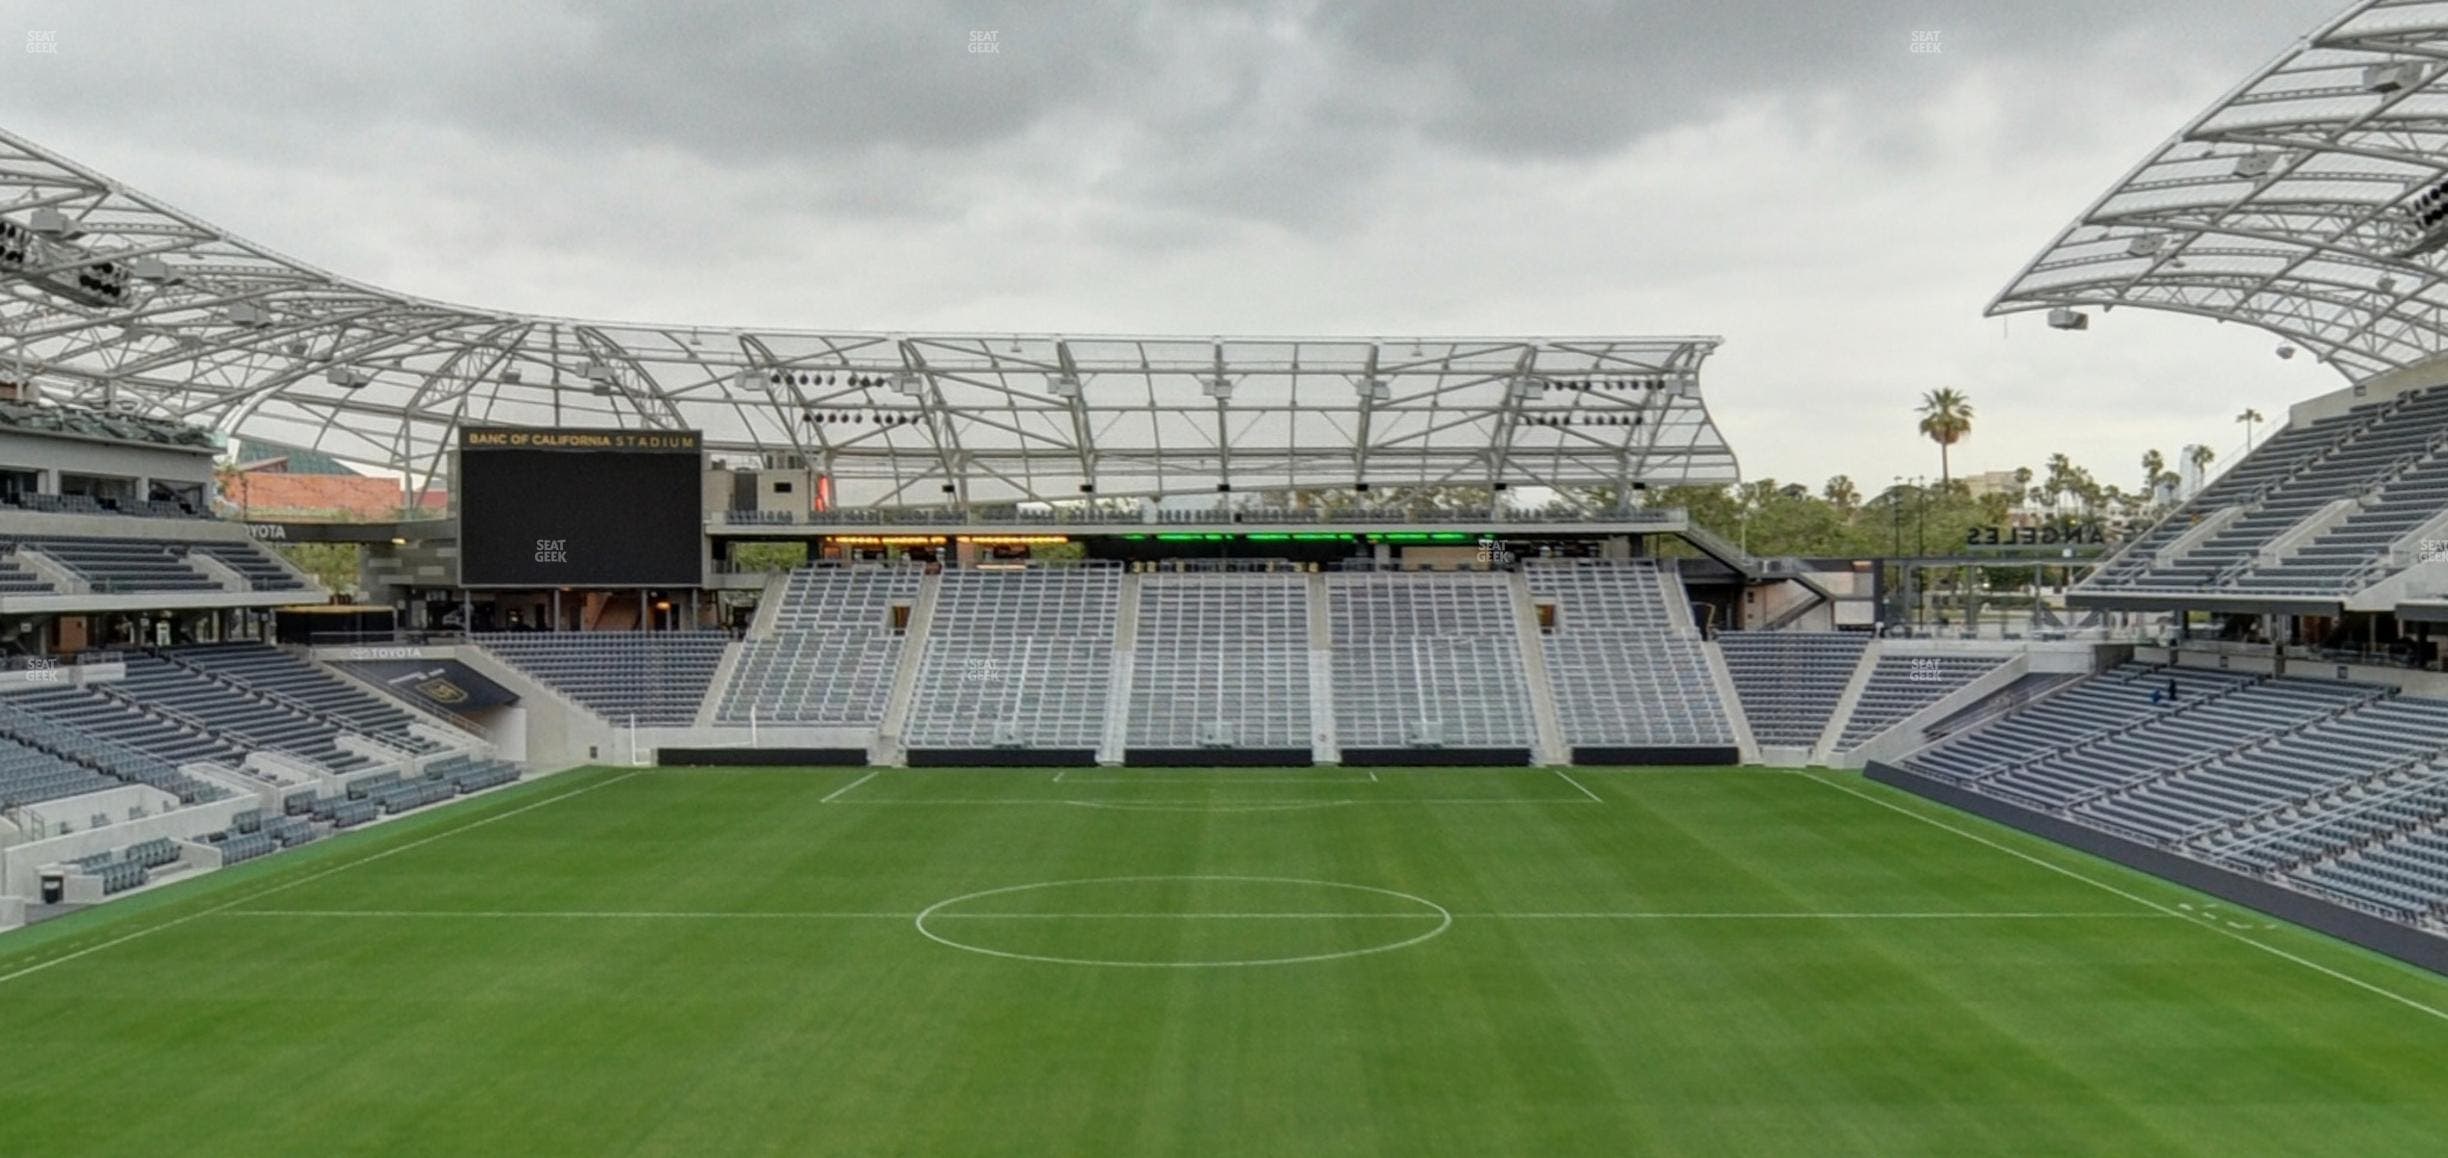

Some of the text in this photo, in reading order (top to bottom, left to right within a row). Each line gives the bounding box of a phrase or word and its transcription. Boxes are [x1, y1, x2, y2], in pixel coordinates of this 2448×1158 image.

[469, 433, 694, 448] BANC OF CALIFORNIA STADIUM
[370, 648, 421, 657] TOYOTA
